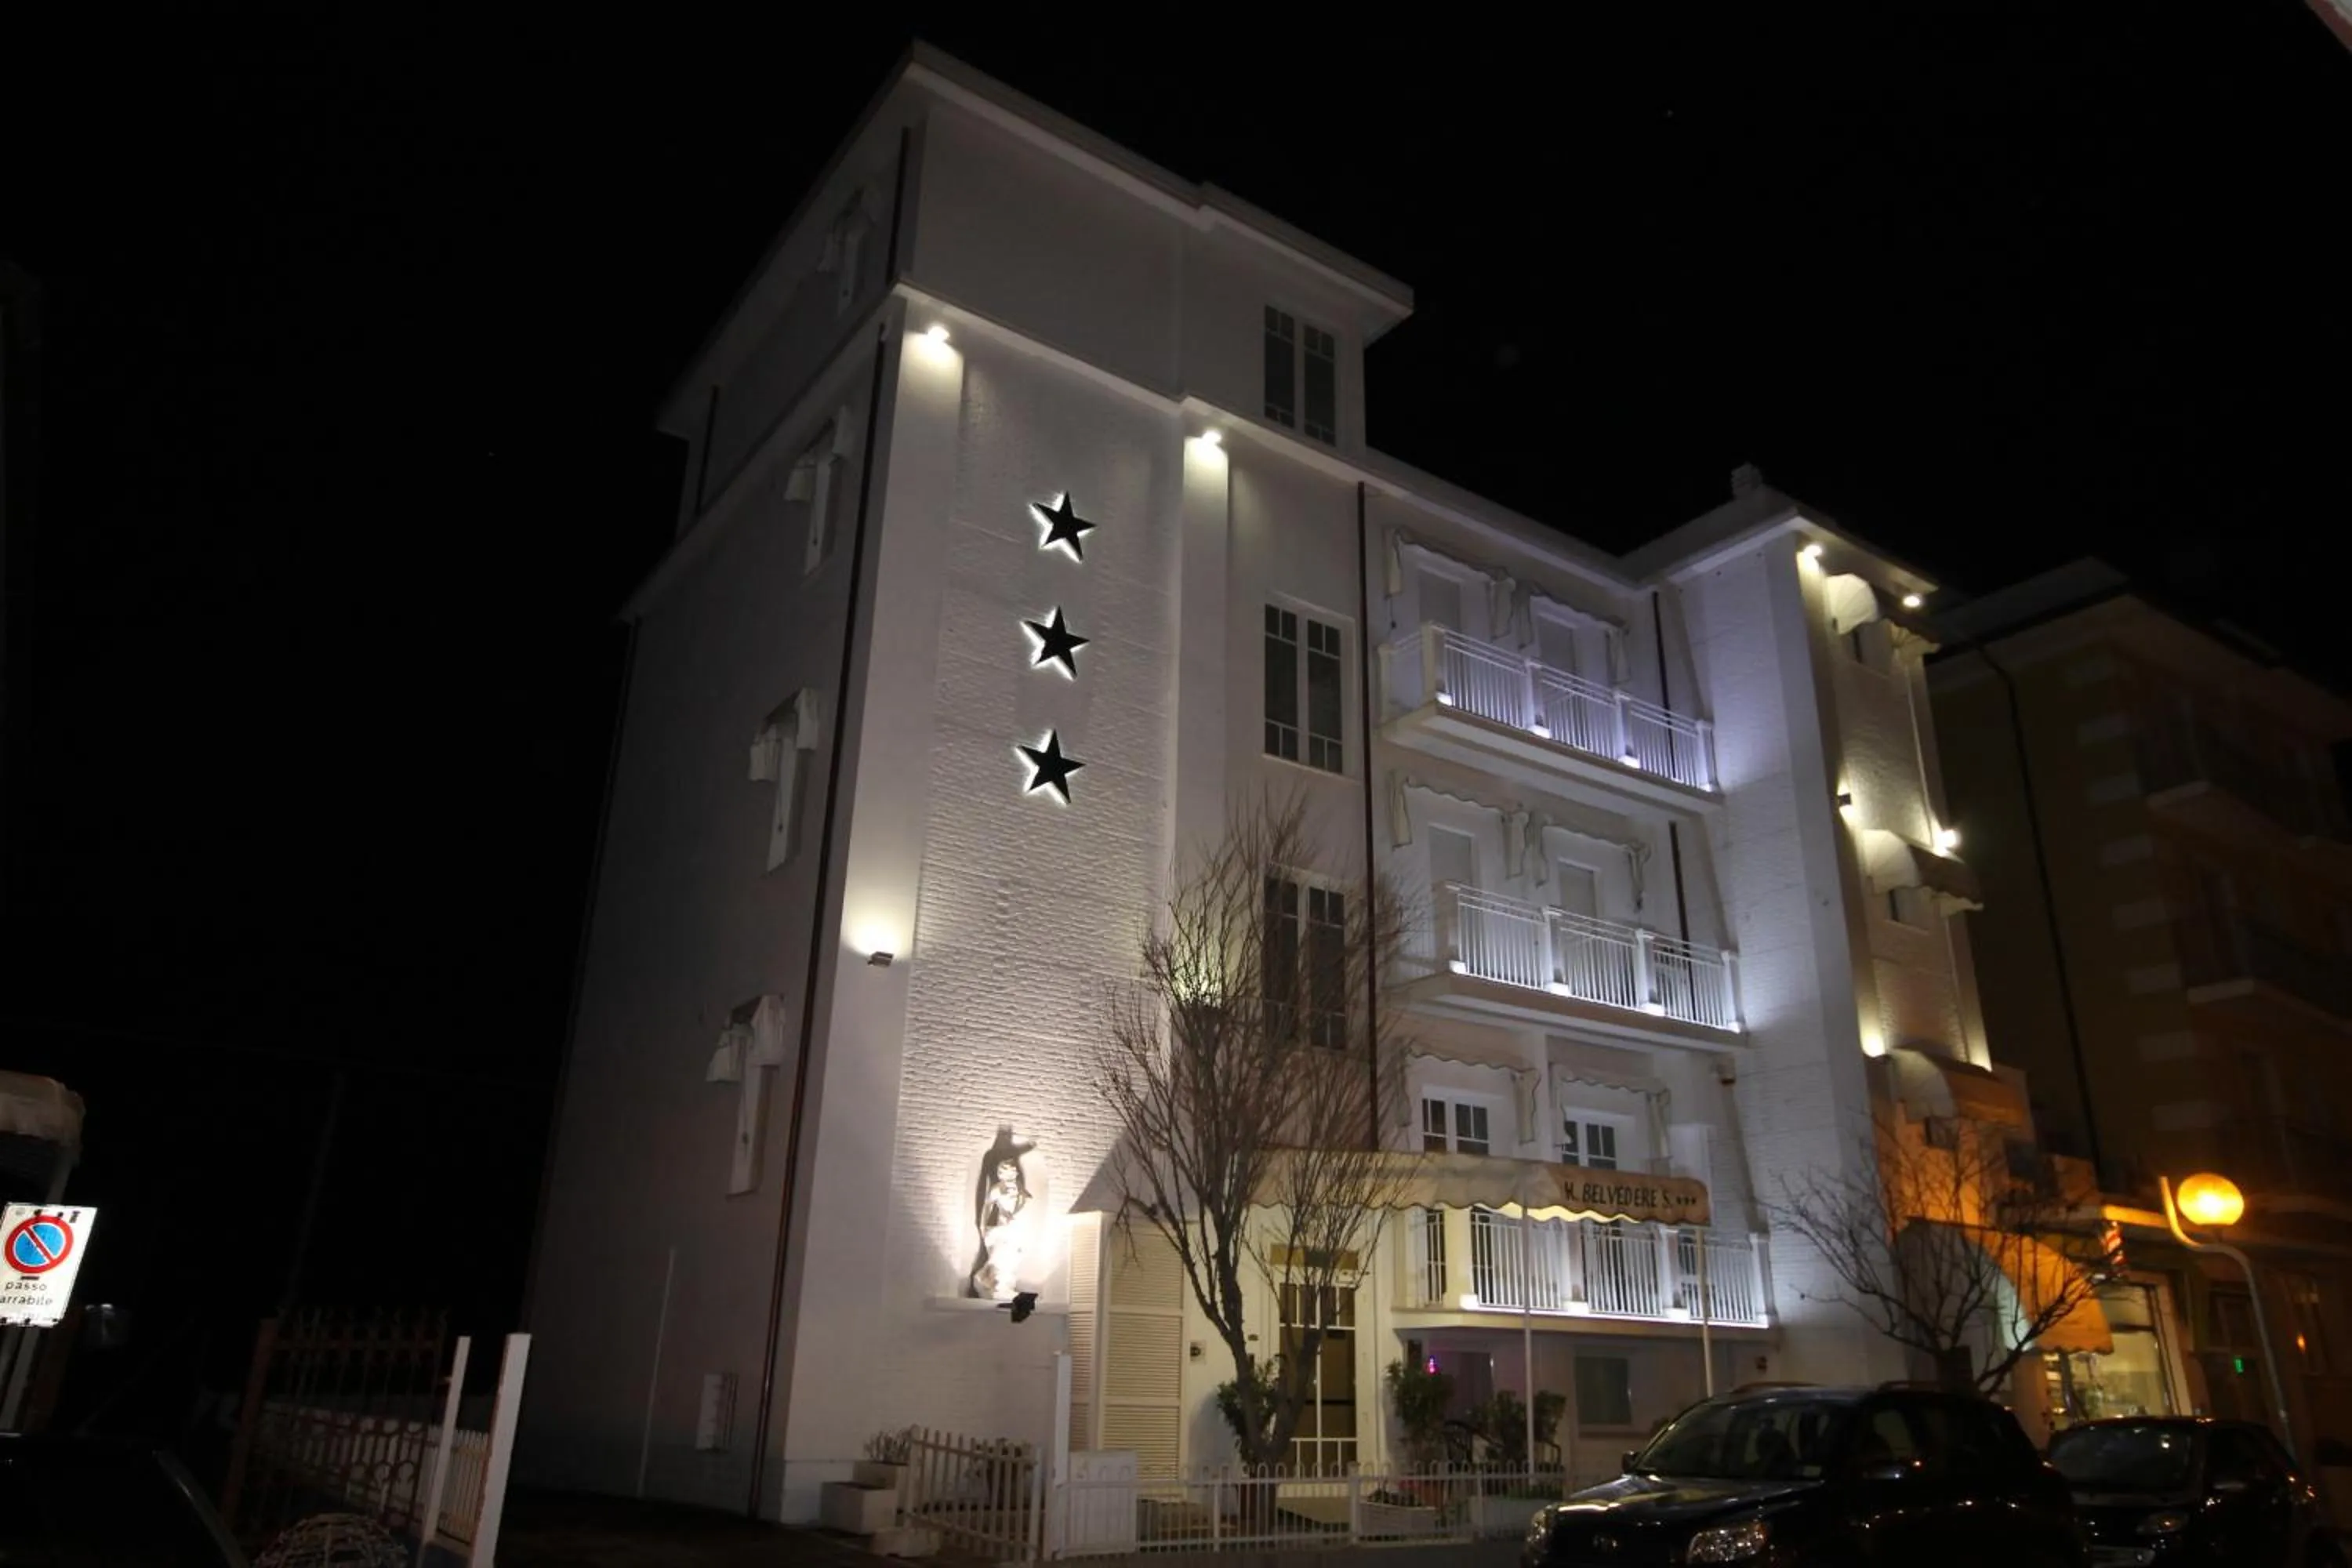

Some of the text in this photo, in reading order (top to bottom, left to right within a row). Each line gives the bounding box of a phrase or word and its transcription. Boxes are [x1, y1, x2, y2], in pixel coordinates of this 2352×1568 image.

[1563, 1181, 1580, 1201] H.
[1582, 1182, 1657, 1207] BELVEDERE
[5, 1280, 48, 1291] passo
